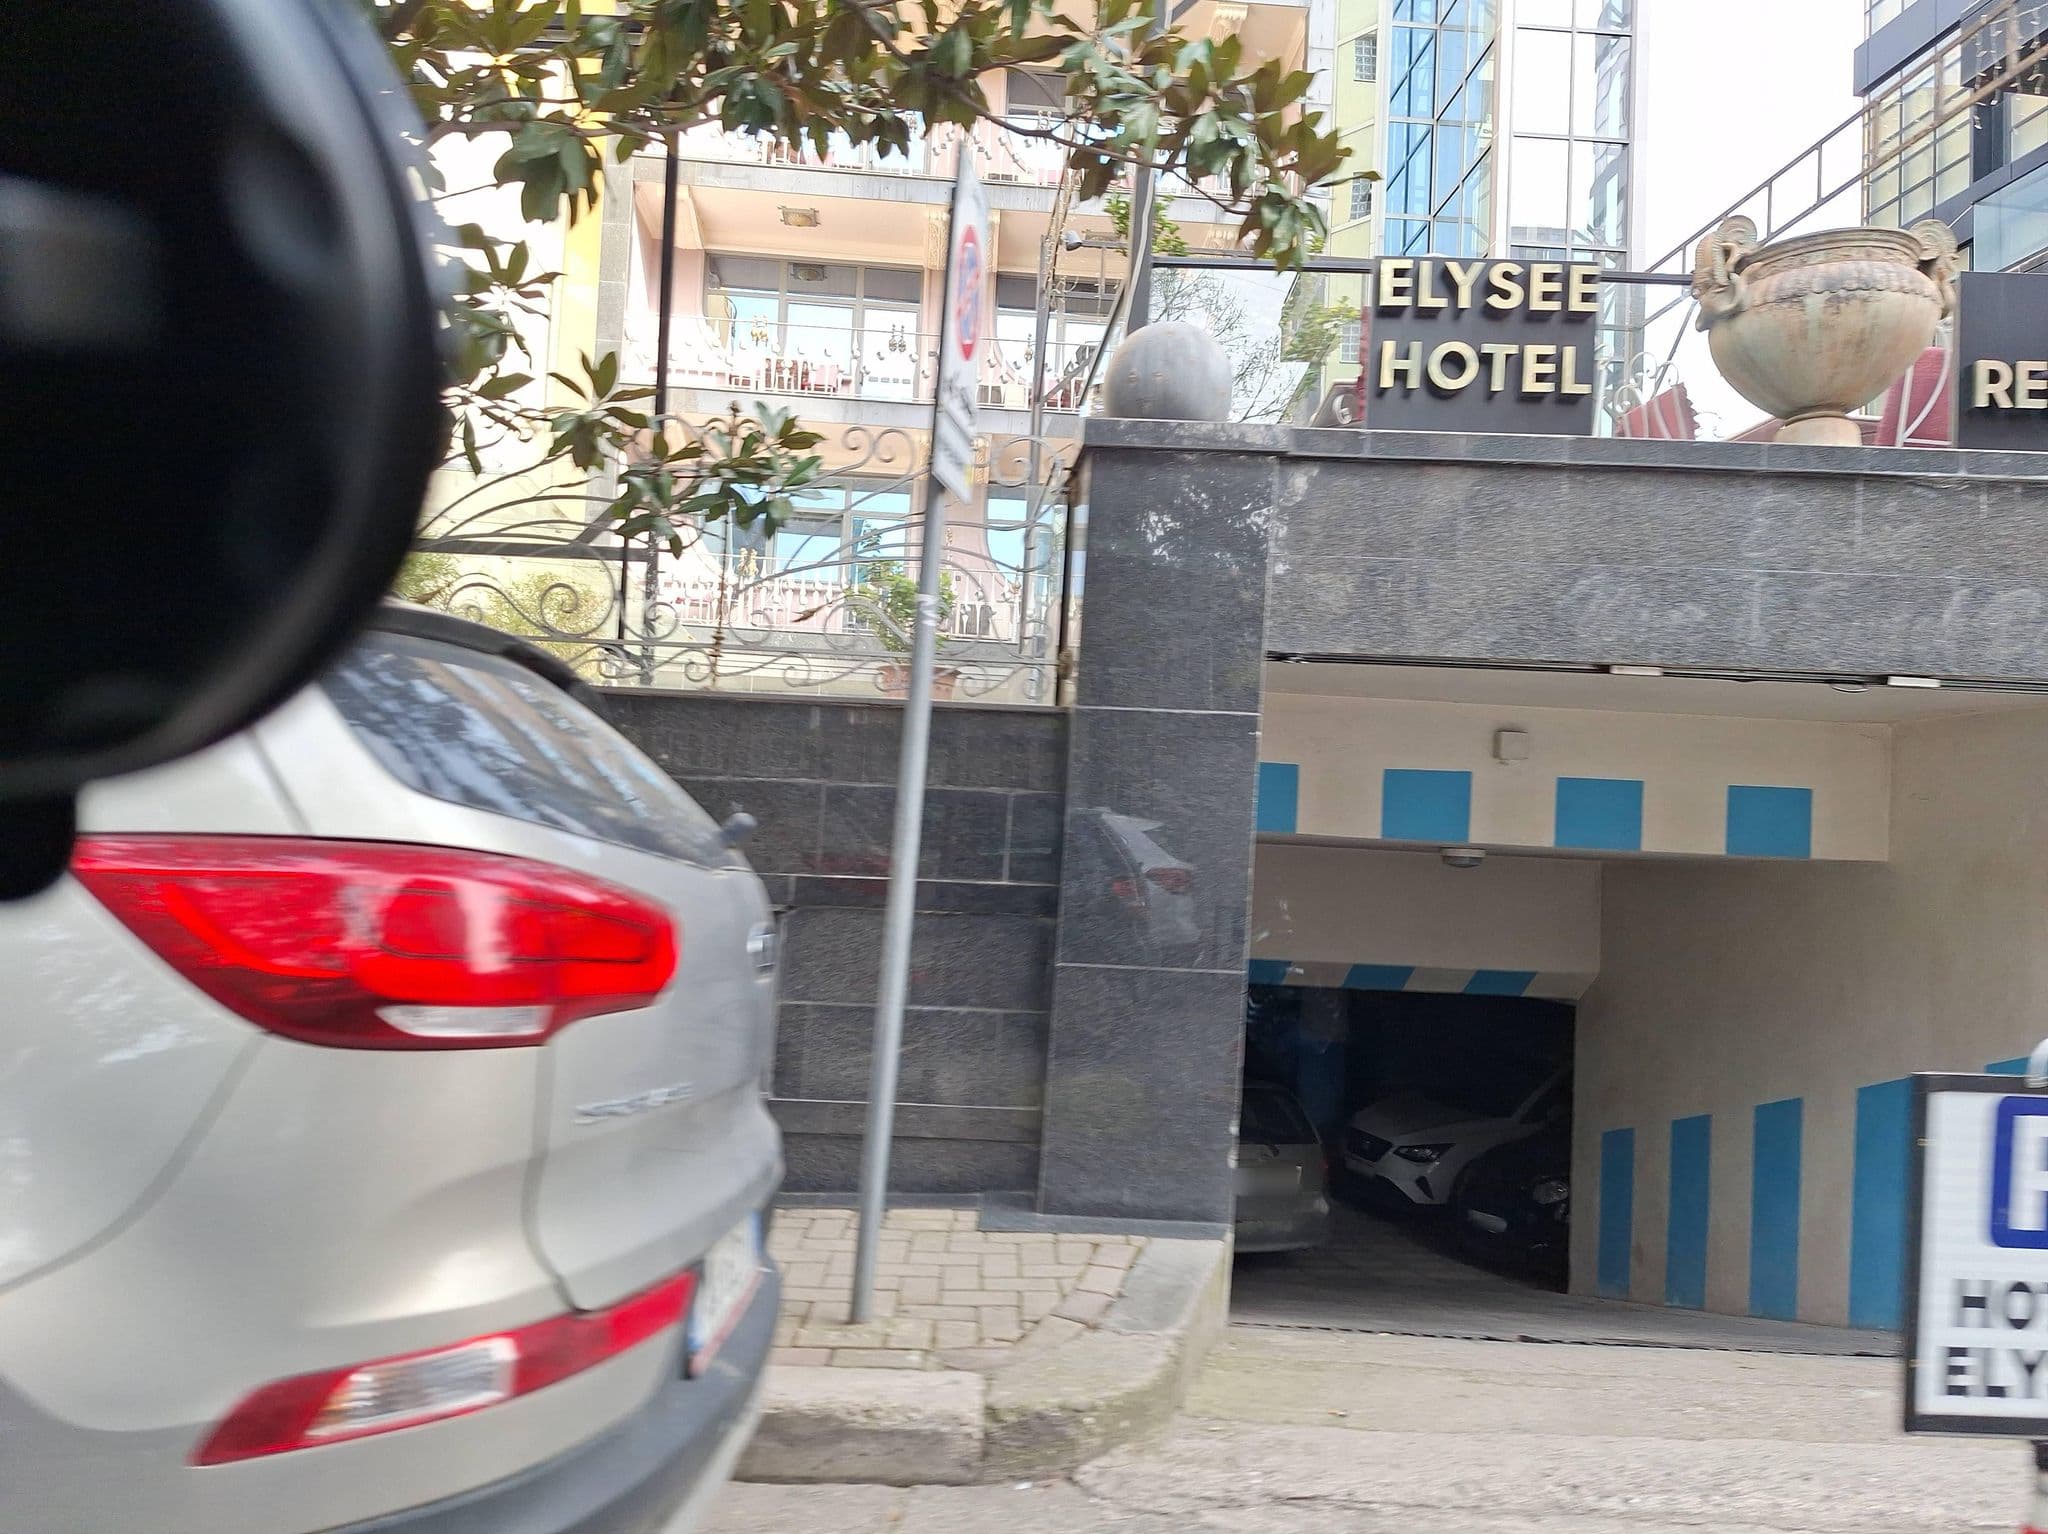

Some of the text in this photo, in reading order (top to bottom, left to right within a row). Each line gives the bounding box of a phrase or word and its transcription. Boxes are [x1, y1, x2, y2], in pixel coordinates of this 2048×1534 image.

[1379, 259, 1600, 312] ELYSEE
[1379, 341, 1592, 394] HOTEL
[1974, 359, 2048, 409] RE
